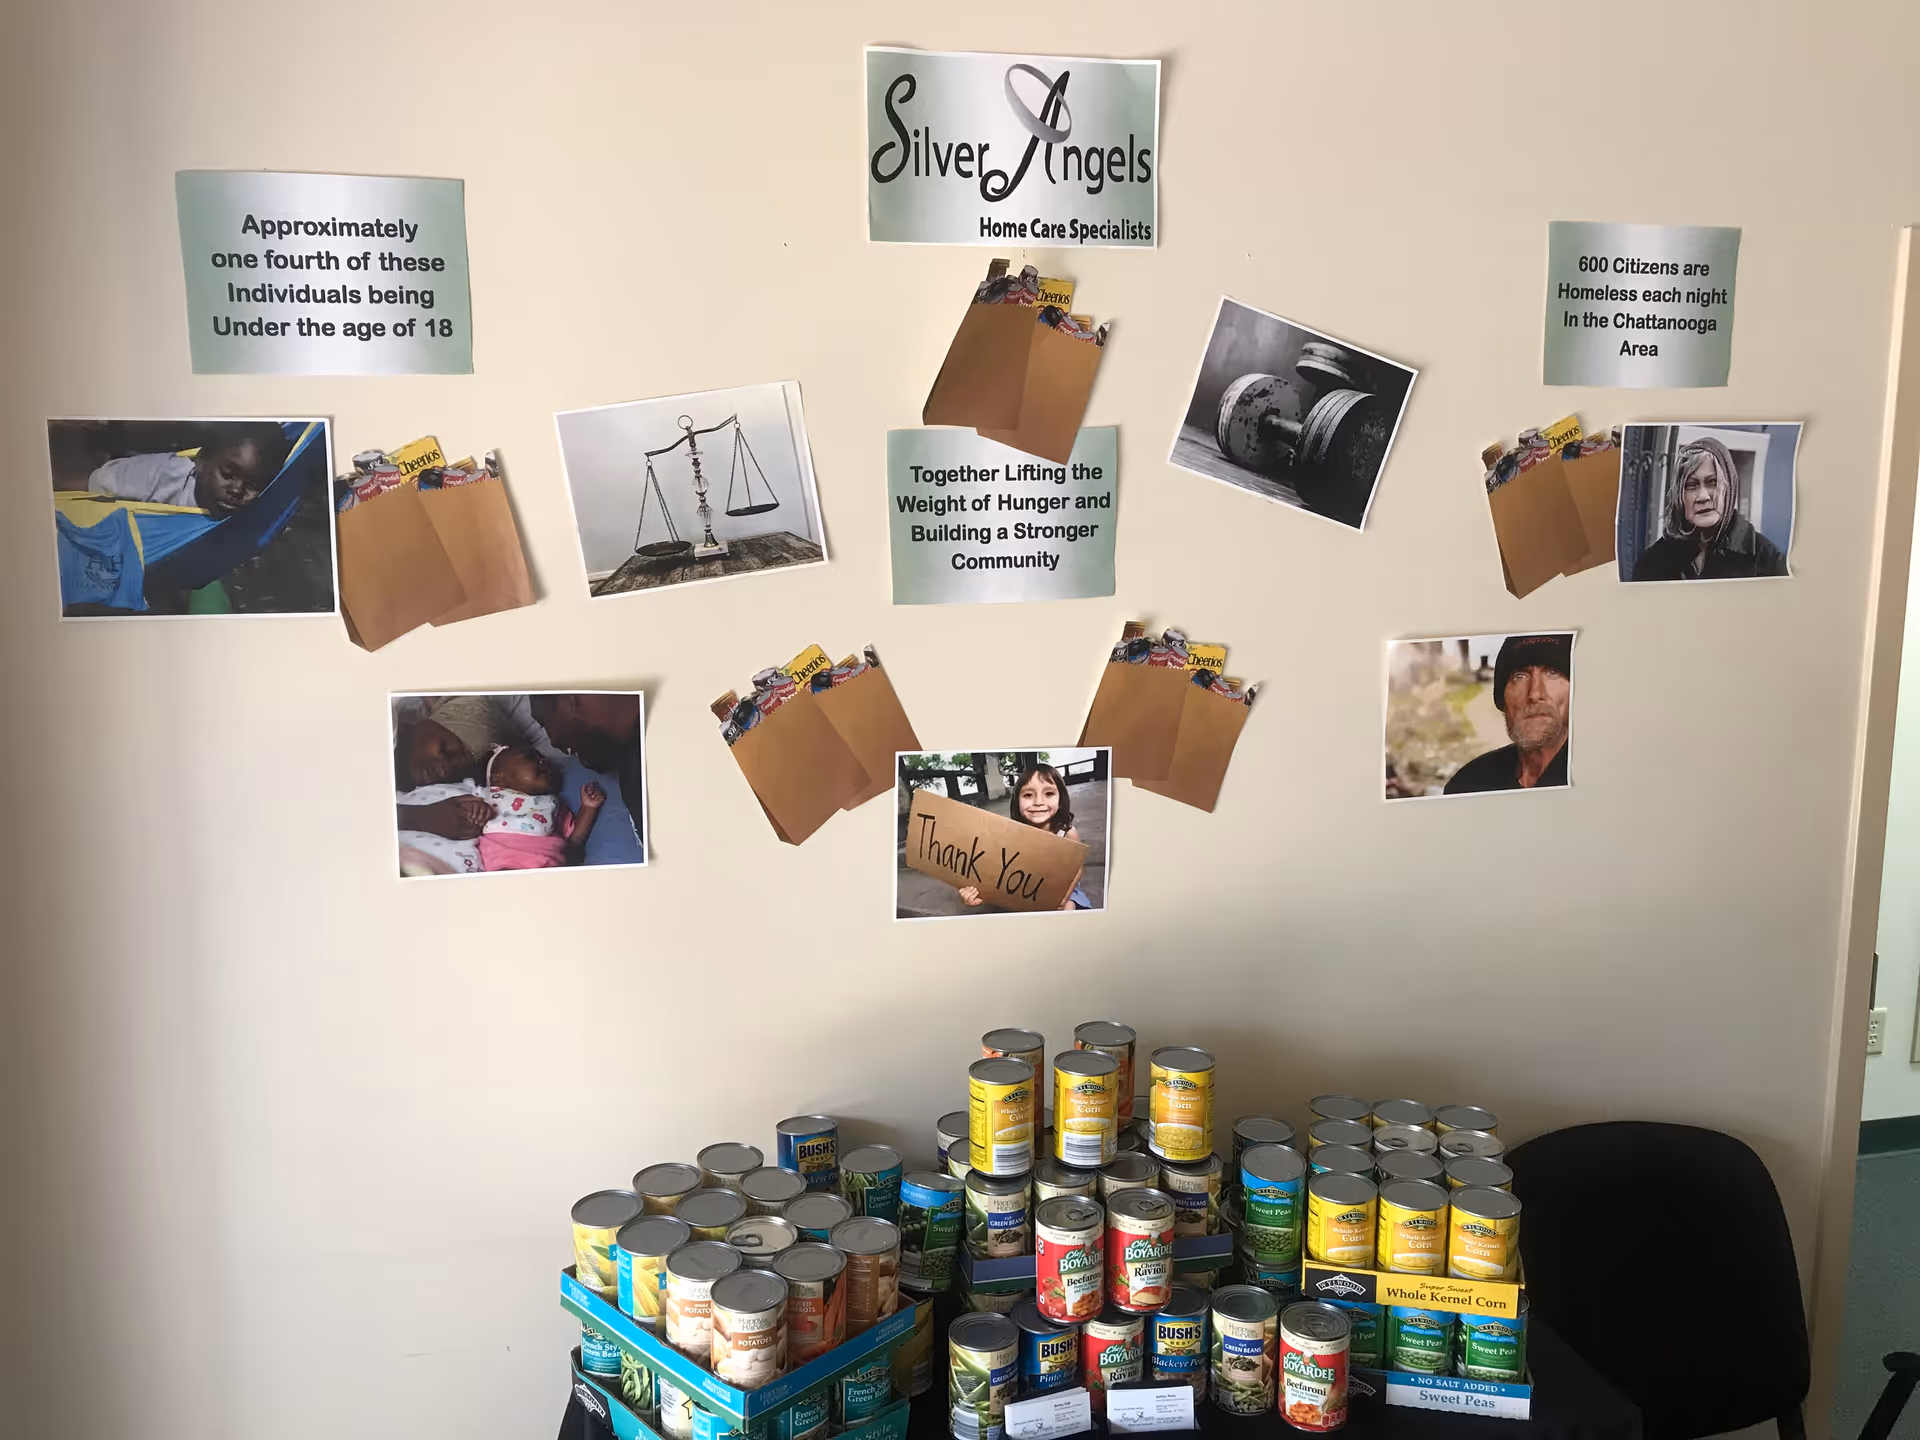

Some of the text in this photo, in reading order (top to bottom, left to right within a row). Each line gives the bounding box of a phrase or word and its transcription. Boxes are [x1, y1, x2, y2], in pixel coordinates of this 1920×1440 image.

[871, 68, 1151, 203] Silver Angels
[241, 214, 418, 243] Approximately
[979, 217, 1152, 244] Home Care Specialists
[211, 249, 445, 272] one fourth of these
[1578, 255, 1710, 276] 600 Citizens are
[227, 282, 435, 309] Individuals being
[1036, 288, 1071, 305] Cheerios
[1558, 283, 1728, 308] Homeless each night
[212, 316, 453, 341] Under the age of 18
[1563, 311, 1717, 335] In the Chattanooga
[1619, 340, 1659, 357] Area
[1549, 425, 1580, 450] Cheerios
[398, 449, 440, 477] Cheerios
[910, 463, 1103, 487] Together Lifting the
[896, 491, 1111, 516] Weight of Hunger and
[911, 522, 1099, 545] Building a Stronger
[951, 551, 1060, 571] Community
[1187, 653, 1223, 668] Cheerios
[791, 653, 826, 686] Cheerios
[917, 812, 1045, 902] Thank You
[1078, 1105, 1101, 1114] Corn
[1169, 1101, 1192, 1109] Corn
[799, 1138, 836, 1158] BUSH'S
[1251, 1203, 1291, 1216] Sweet Peas
[933, 1224, 954, 1232] Sweet
[1008, 1217, 1024, 1226] BEANS
[1400, 1232, 1420, 1240] Whole
[1125, 1242, 1172, 1260] BOYARDEE
[1131, 1240, 1149, 1250] Chef
[1408, 1241, 1432, 1249] Corn
[1465, 1245, 1490, 1257] Corn
[1479, 1241, 1500, 1249] Kernel
[1066, 1250, 1083, 1259] Chef
[1134, 1264, 1167, 1277] Ravioli
[1319, 1280, 1364, 1294] WYLWOOD
[1420, 1282, 1474, 1293] Super Sweet
[1386, 1287, 1507, 1309] Whole Kernel Corn
[684, 1307, 712, 1315] POTATO
[738, 1317, 769, 1327] Happy
[1158, 1324, 1201, 1339] BUSH'S
[1359, 1332, 1375, 1340] Peas
[738, 1336, 772, 1347] POTATOES
[1042, 1335, 1078, 1358] BUSH'S
[1224, 1344, 1243, 1352] GREEN
[1400, 1334, 1443, 1347] Sweet Peas
[602, 1350, 622, 1358] Bean
[1106, 1345, 1125, 1353] Chef
[1472, 1342, 1516, 1356] Sweet Peas
[1152, 1356, 1189, 1368] Blackeye
[1287, 1352, 1300, 1364] Chef
[1284, 1356, 1334, 1380] BOYARDEE
[1040, 1372, 1061, 1383] Pinto
[1418, 1377, 1499, 1393] NO SALT ADDED
[848, 1388, 875, 1397] French
[1286, 1377, 1326, 1396] Beefaroni
[848, 1394, 873, 1403] Green
[1419, 1390, 1495, 1409] Sweet Peas
[795, 1405, 820, 1420] French
[795, 1415, 820, 1426] Green
